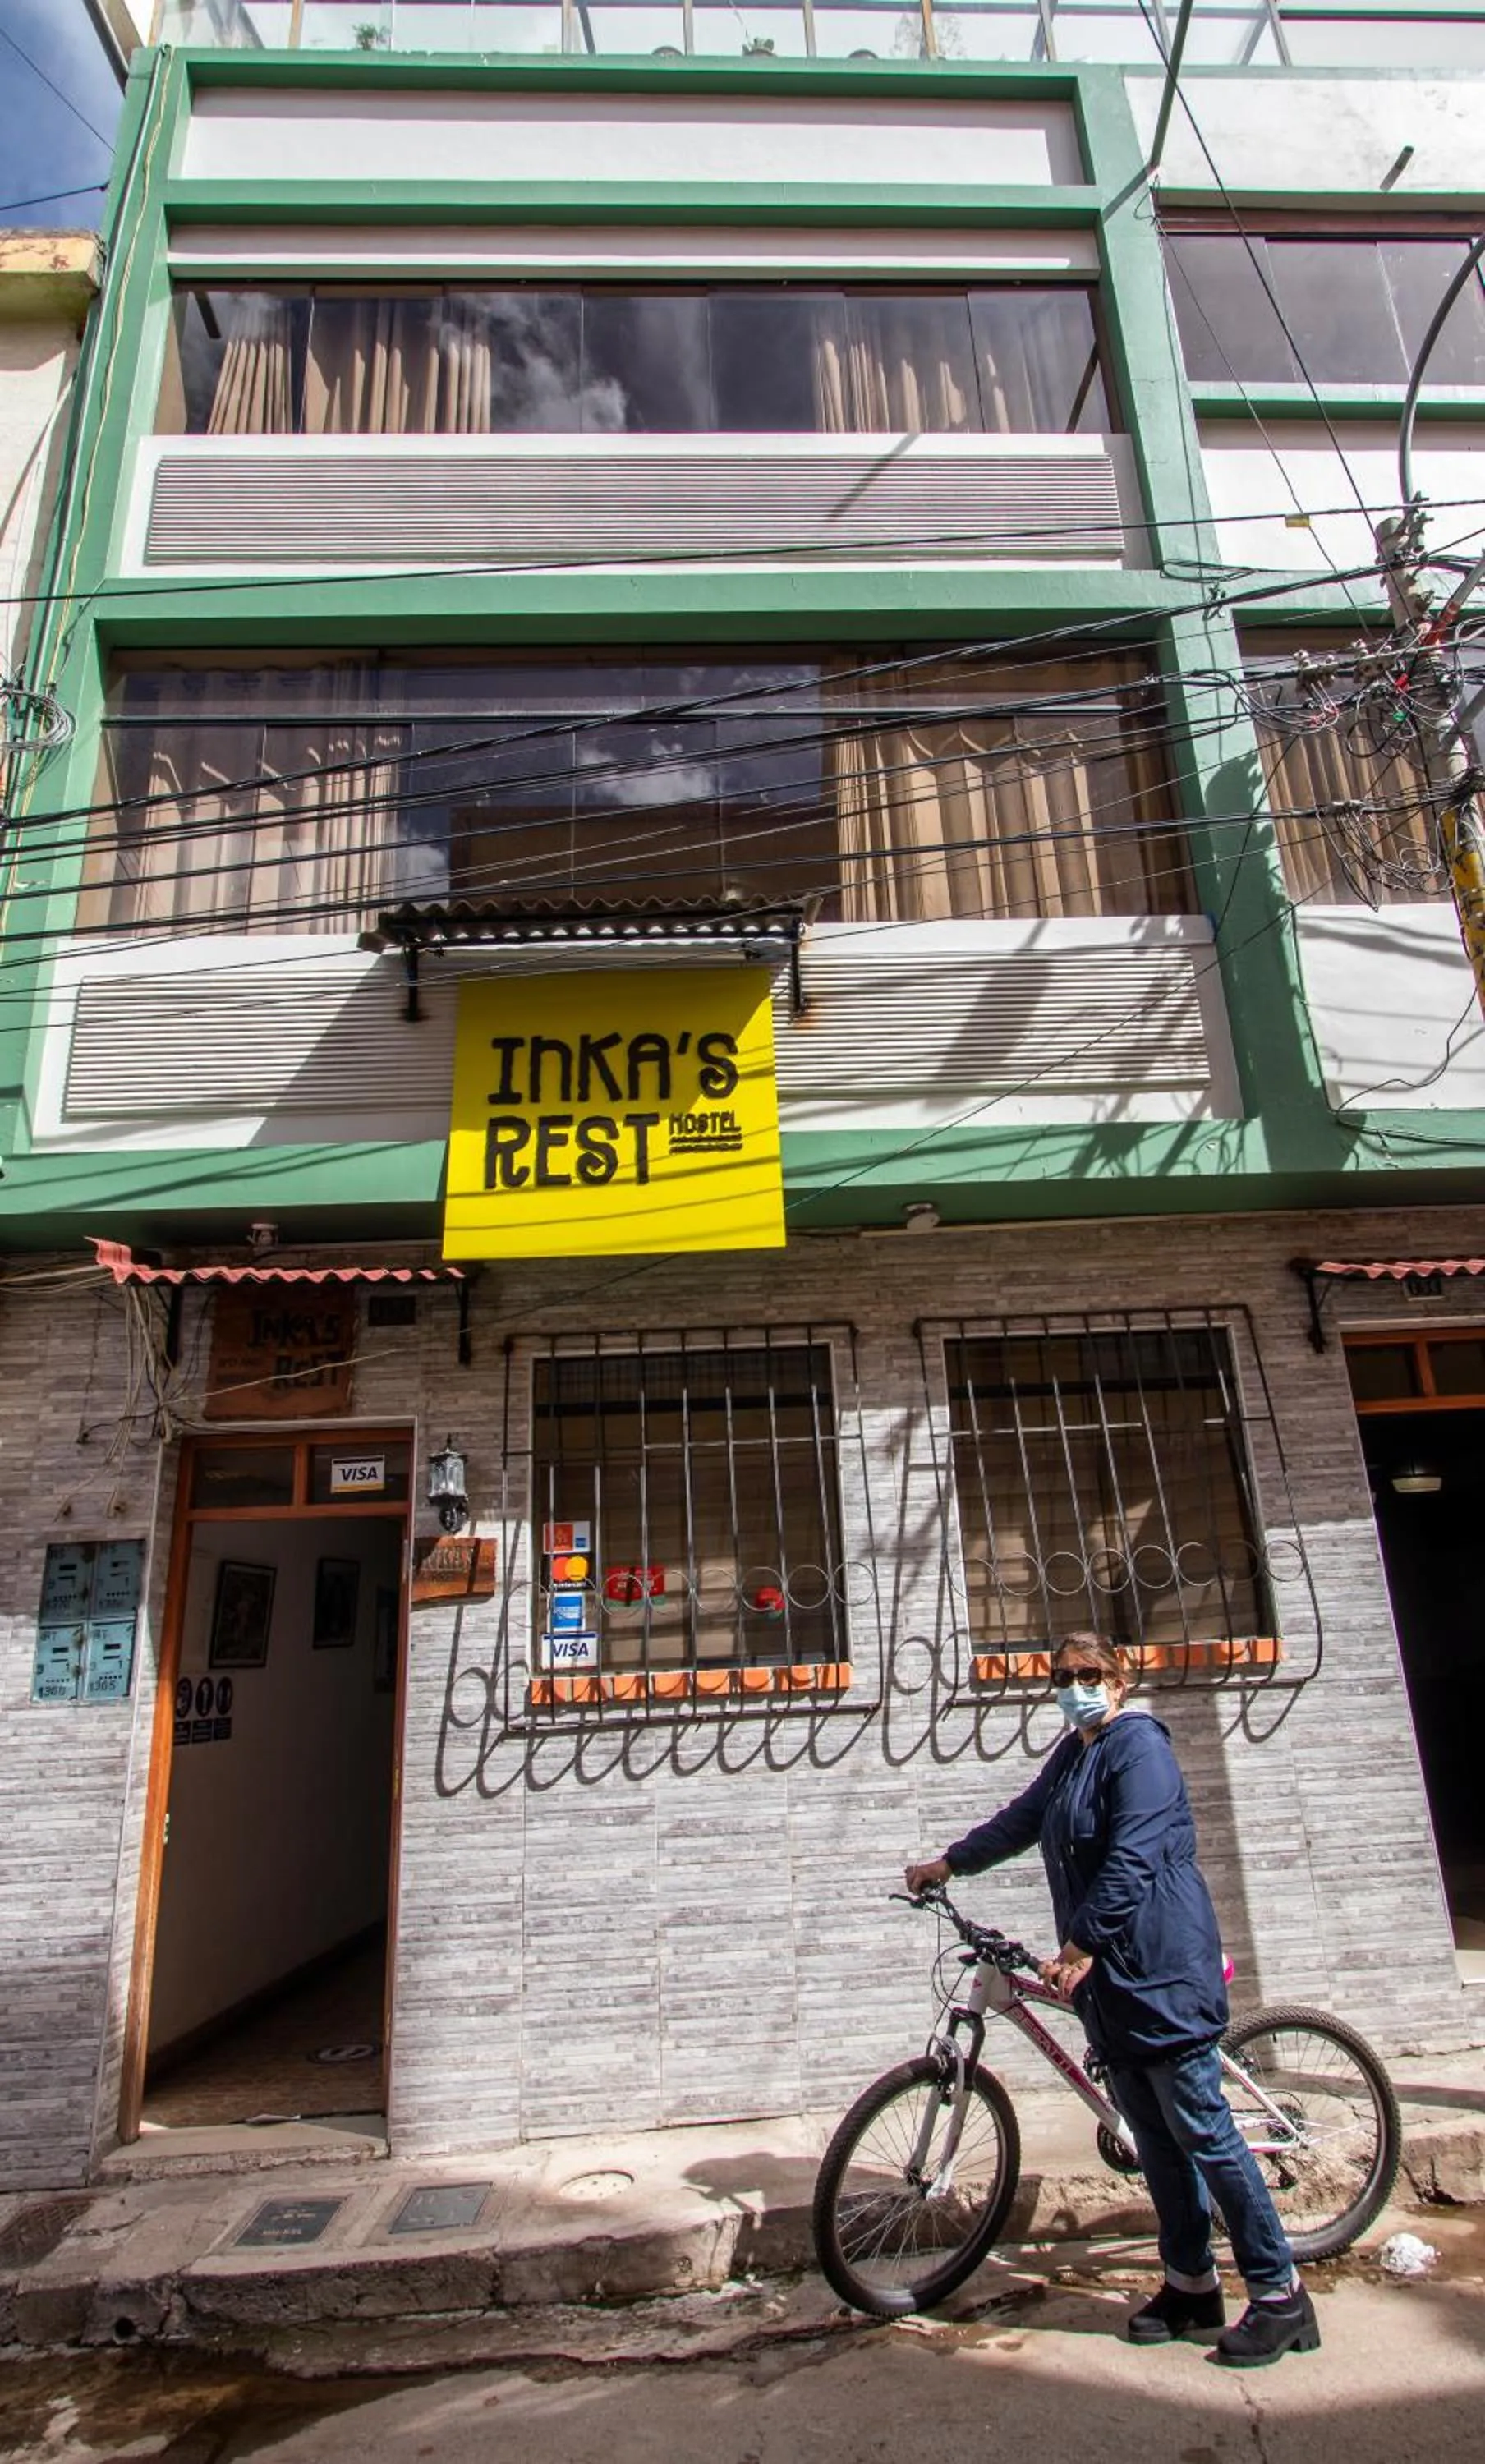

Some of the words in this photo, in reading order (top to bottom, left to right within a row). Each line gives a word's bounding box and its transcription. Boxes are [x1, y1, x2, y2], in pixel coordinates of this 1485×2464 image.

[669, 1110, 740, 1135] HOSTEL
[484, 1113, 660, 1190] REST
[338, 1466, 378, 1481] VISA
[552, 1642, 589, 1657] VISA
